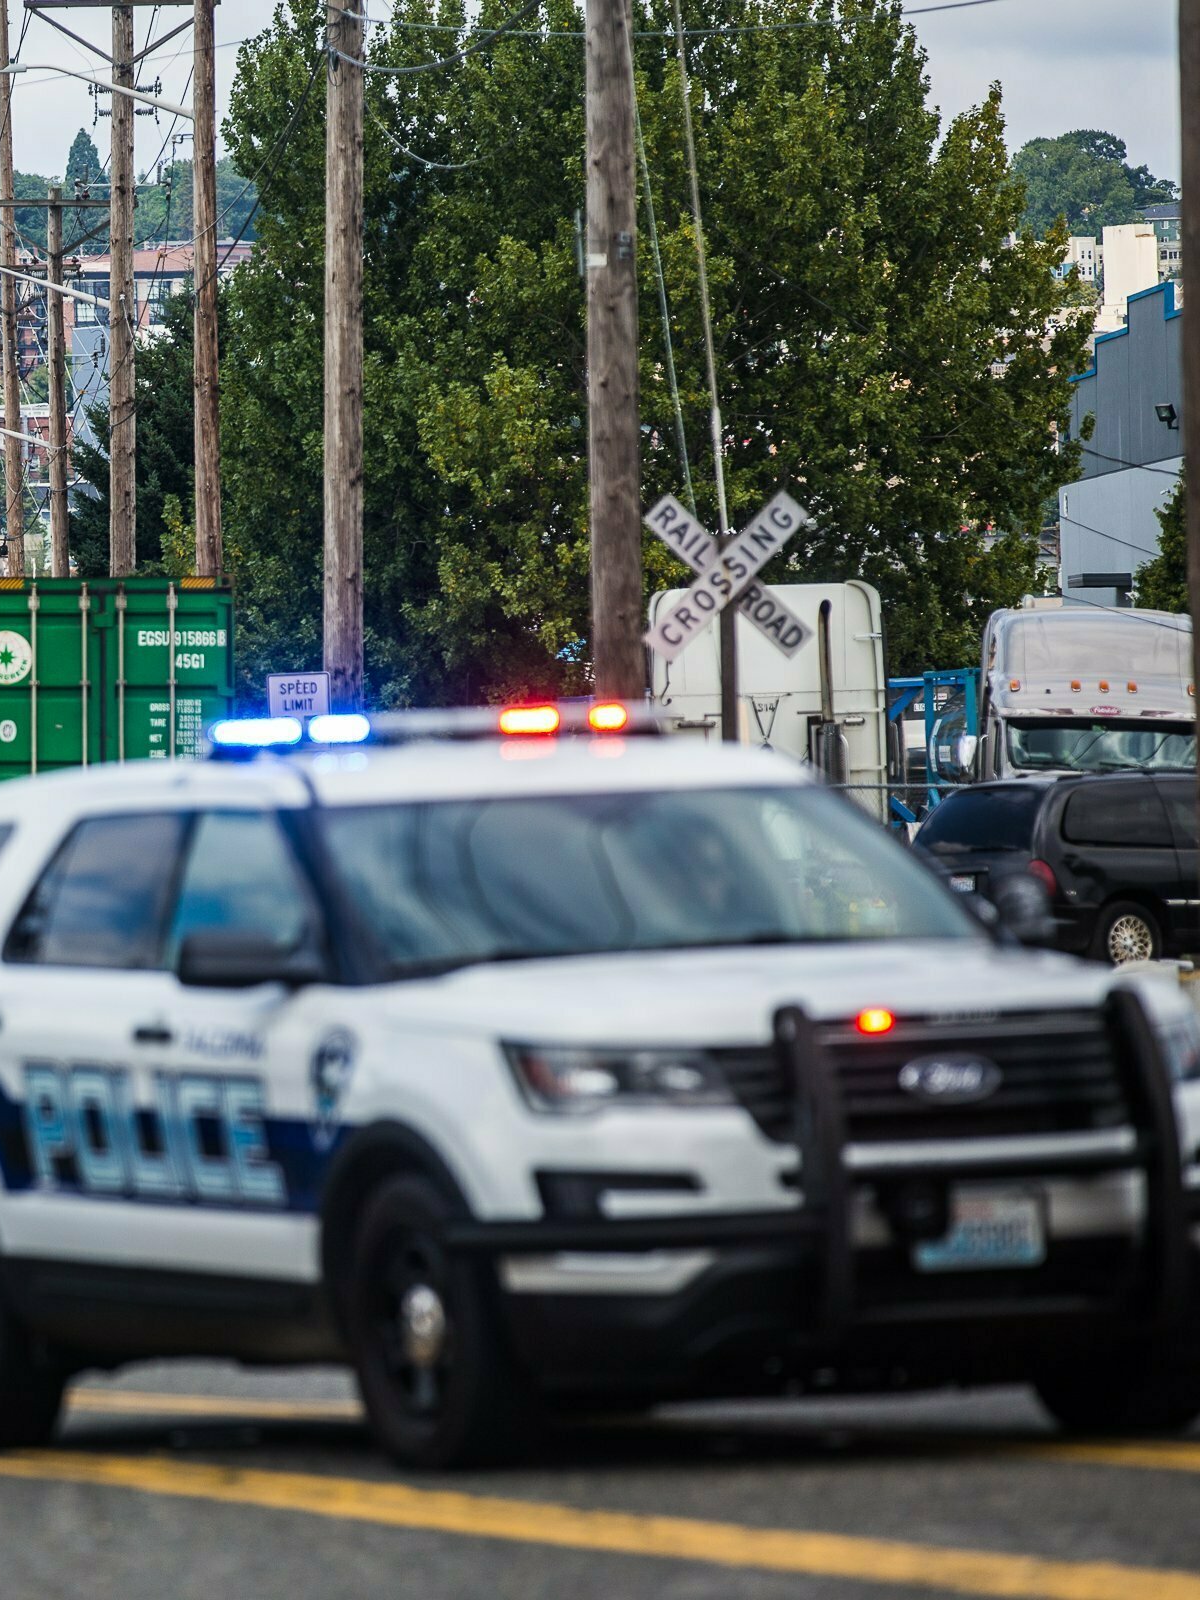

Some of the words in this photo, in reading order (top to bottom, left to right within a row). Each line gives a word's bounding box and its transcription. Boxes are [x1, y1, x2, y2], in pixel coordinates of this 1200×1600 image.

[654, 505, 711, 567] RAIL
[742, 586, 804, 648] ROAD
[660, 507, 793, 646] CROSSING
[137, 630, 169, 646] EGSU
[280, 681, 318, 695] SPEED
[149, 702, 171, 712] GROSS
[284, 698, 314, 712] LIMIT
[150, 718, 167, 727] TARE
[149, 734, 163, 743] NET
[22, 1059, 286, 1204] POLICE
